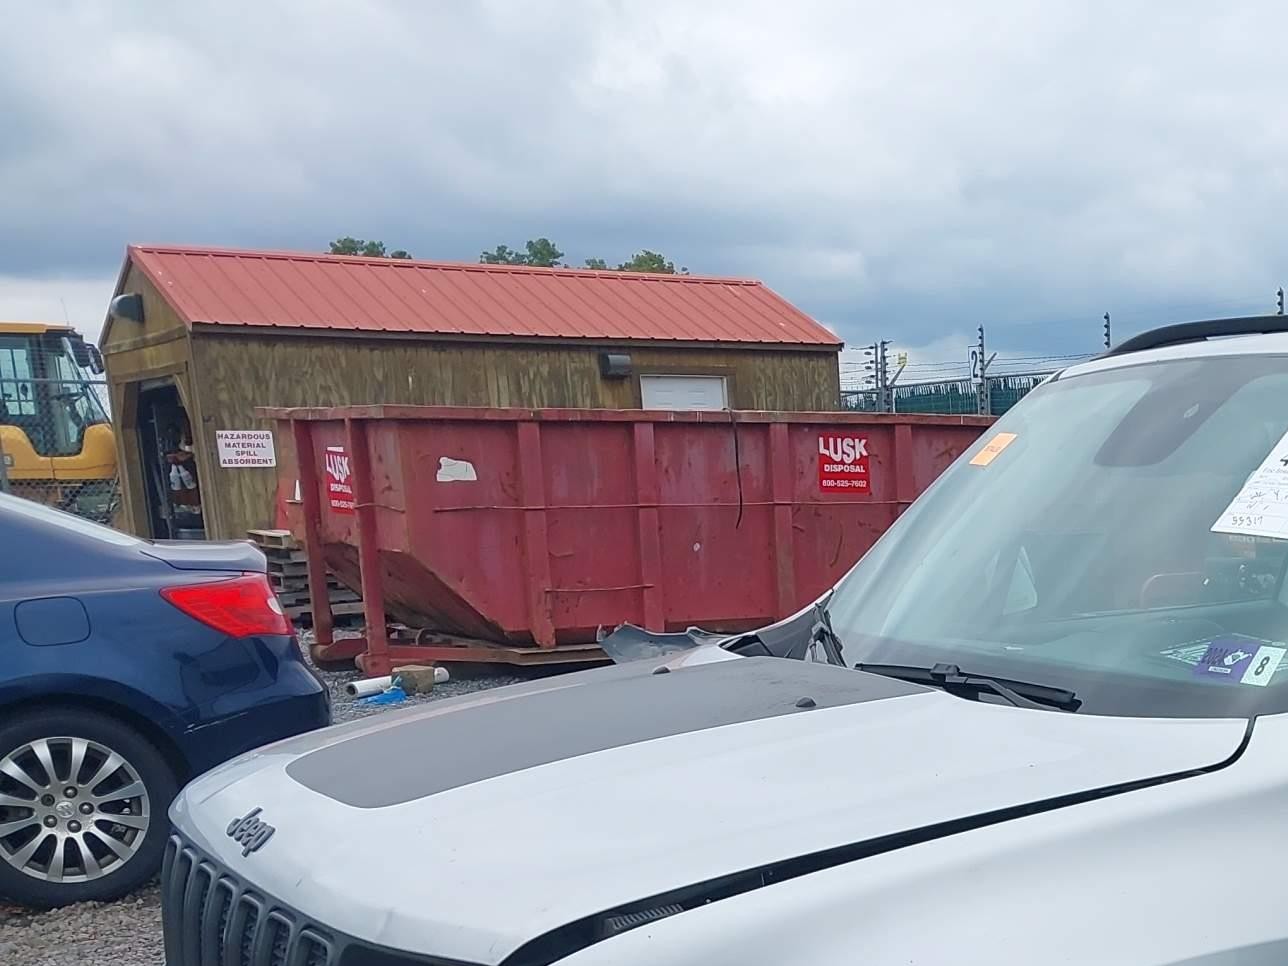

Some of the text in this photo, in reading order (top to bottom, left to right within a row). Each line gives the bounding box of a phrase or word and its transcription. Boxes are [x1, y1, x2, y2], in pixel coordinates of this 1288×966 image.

[971, 350, 979, 378] 2
[818, 436, 869, 464] LUSK
[326, 454, 350, 483] LUSK
[824, 464, 866, 473] DISPOSAL
[1253, 655, 1271, 676] 8
[226, 806, 277, 858] Jeep
